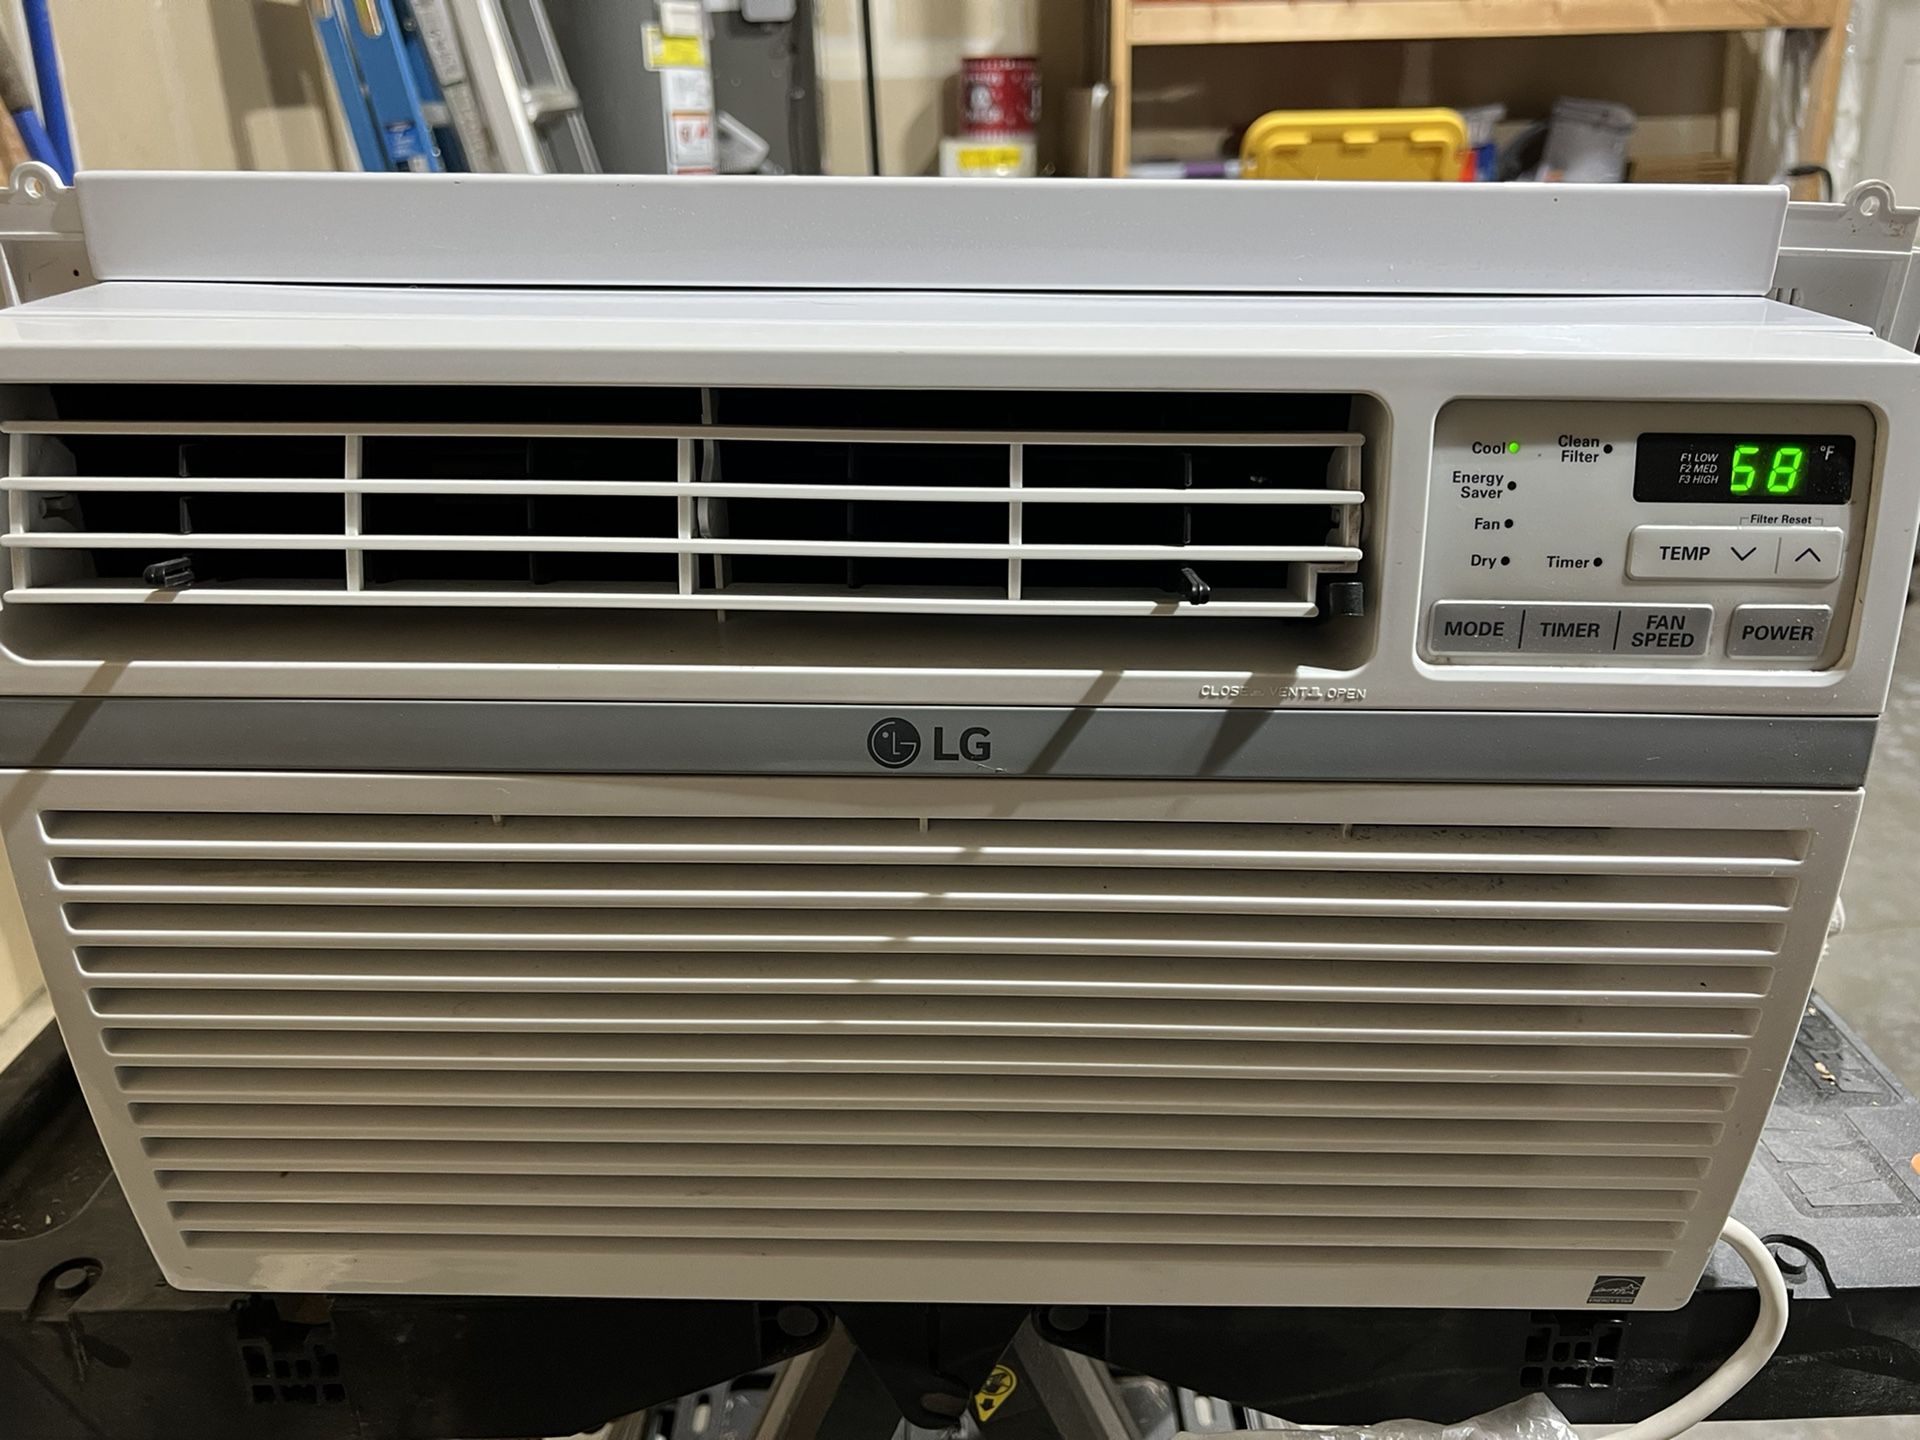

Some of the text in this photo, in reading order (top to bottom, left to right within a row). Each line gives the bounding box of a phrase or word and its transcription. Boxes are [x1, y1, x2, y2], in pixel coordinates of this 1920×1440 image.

[1471, 441, 1506, 455] Cool
[1558, 434, 1600, 448] Clean
[1561, 449, 1599, 463] Filter
[1680, 452, 1719, 462] F1 LOW
[1679, 463, 1718, 473] F2 MED
[1730, 447, 1803, 492] 68
[1452, 470, 1504, 486] Energy
[1678, 474, 1719, 484] F3 HIGH
[1460, 486, 1503, 499] Saver
[1474, 517, 1500, 530] Fan
[1750, 513, 1812, 524] Filter Reset
[1659, 546, 1710, 561] TEMP
[1470, 554, 1497, 569] Dry
[1547, 555, 1589, 568] Timer
[1444, 621, 1504, 636] MODE
[1540, 622, 1600, 638] TIMER
[1646, 615, 1685, 630] FAN
[1631, 632, 1694, 648] SPEED
[1741, 625, 1814, 641] POWER
[1200, 684, 1367, 699] CLOSE VENT OPEN
[933, 726, 991, 761] LG
